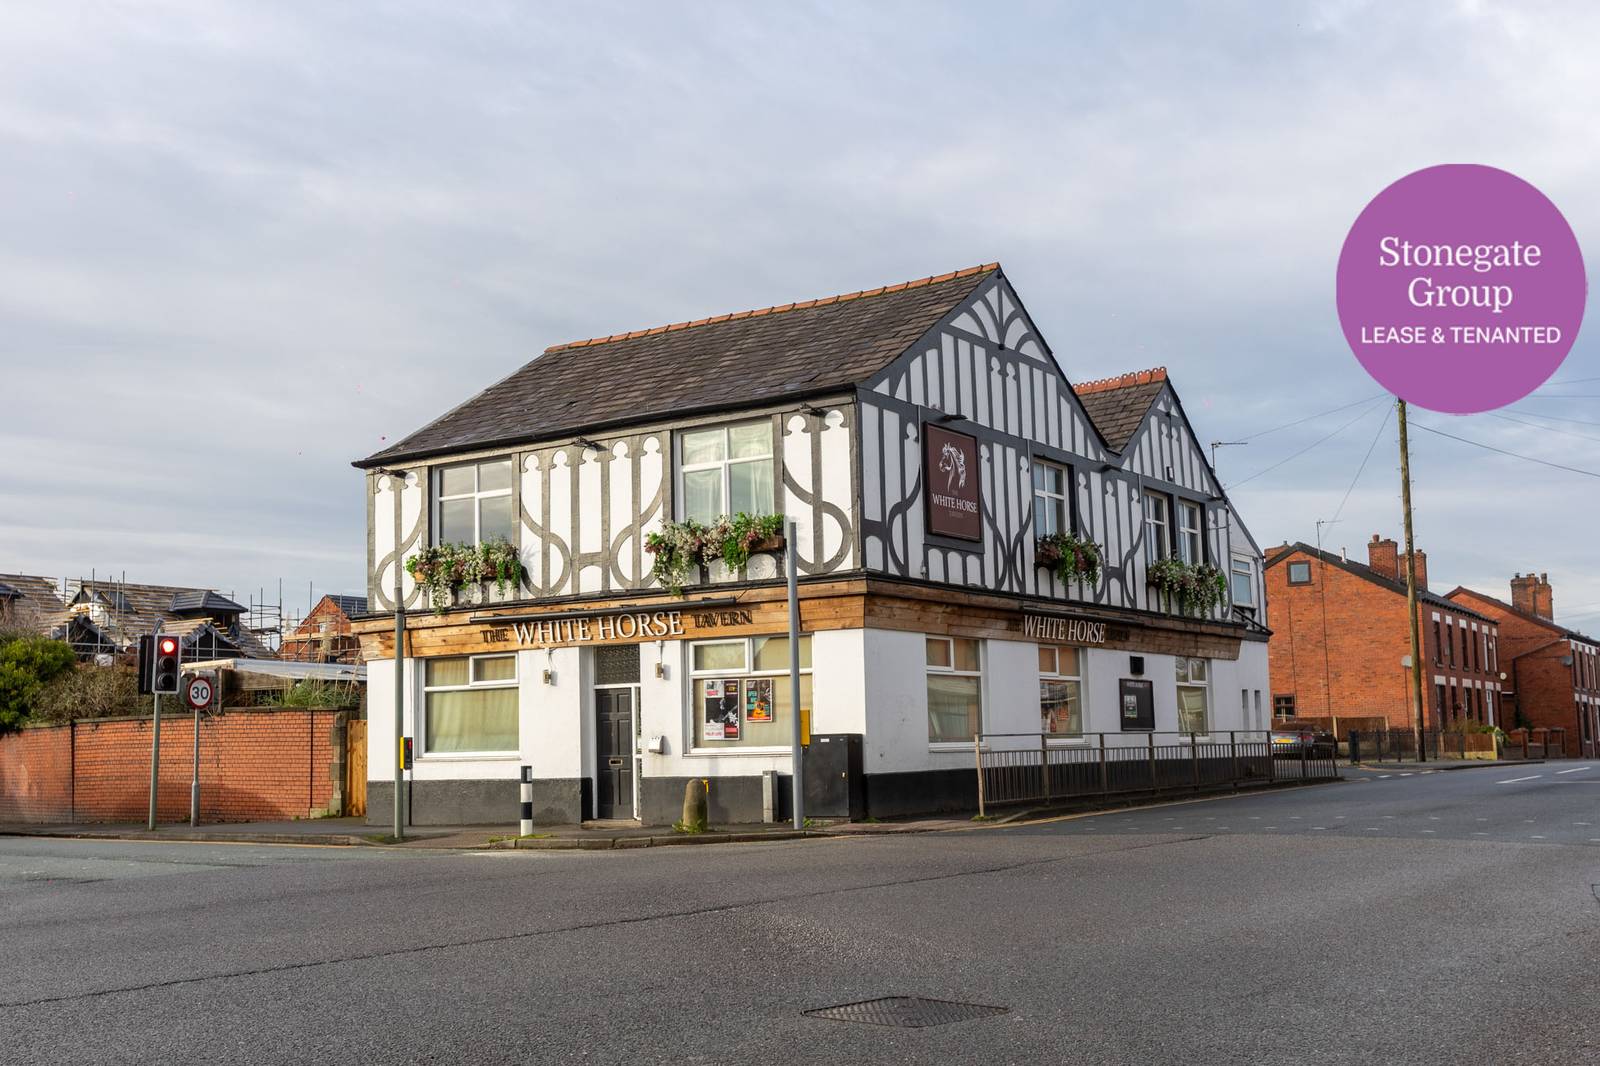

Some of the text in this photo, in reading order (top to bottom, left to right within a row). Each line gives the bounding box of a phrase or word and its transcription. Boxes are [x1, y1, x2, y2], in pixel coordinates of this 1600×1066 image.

[933, 493, 977, 513] WHITE HORSE
[480, 610, 753, 645] THE WHITE HORSE TAVERN
[1024, 615, 1066, 640] WHITE
[1068, 619, 1106, 643] HORSE
[192, 686, 209, 699] 30
